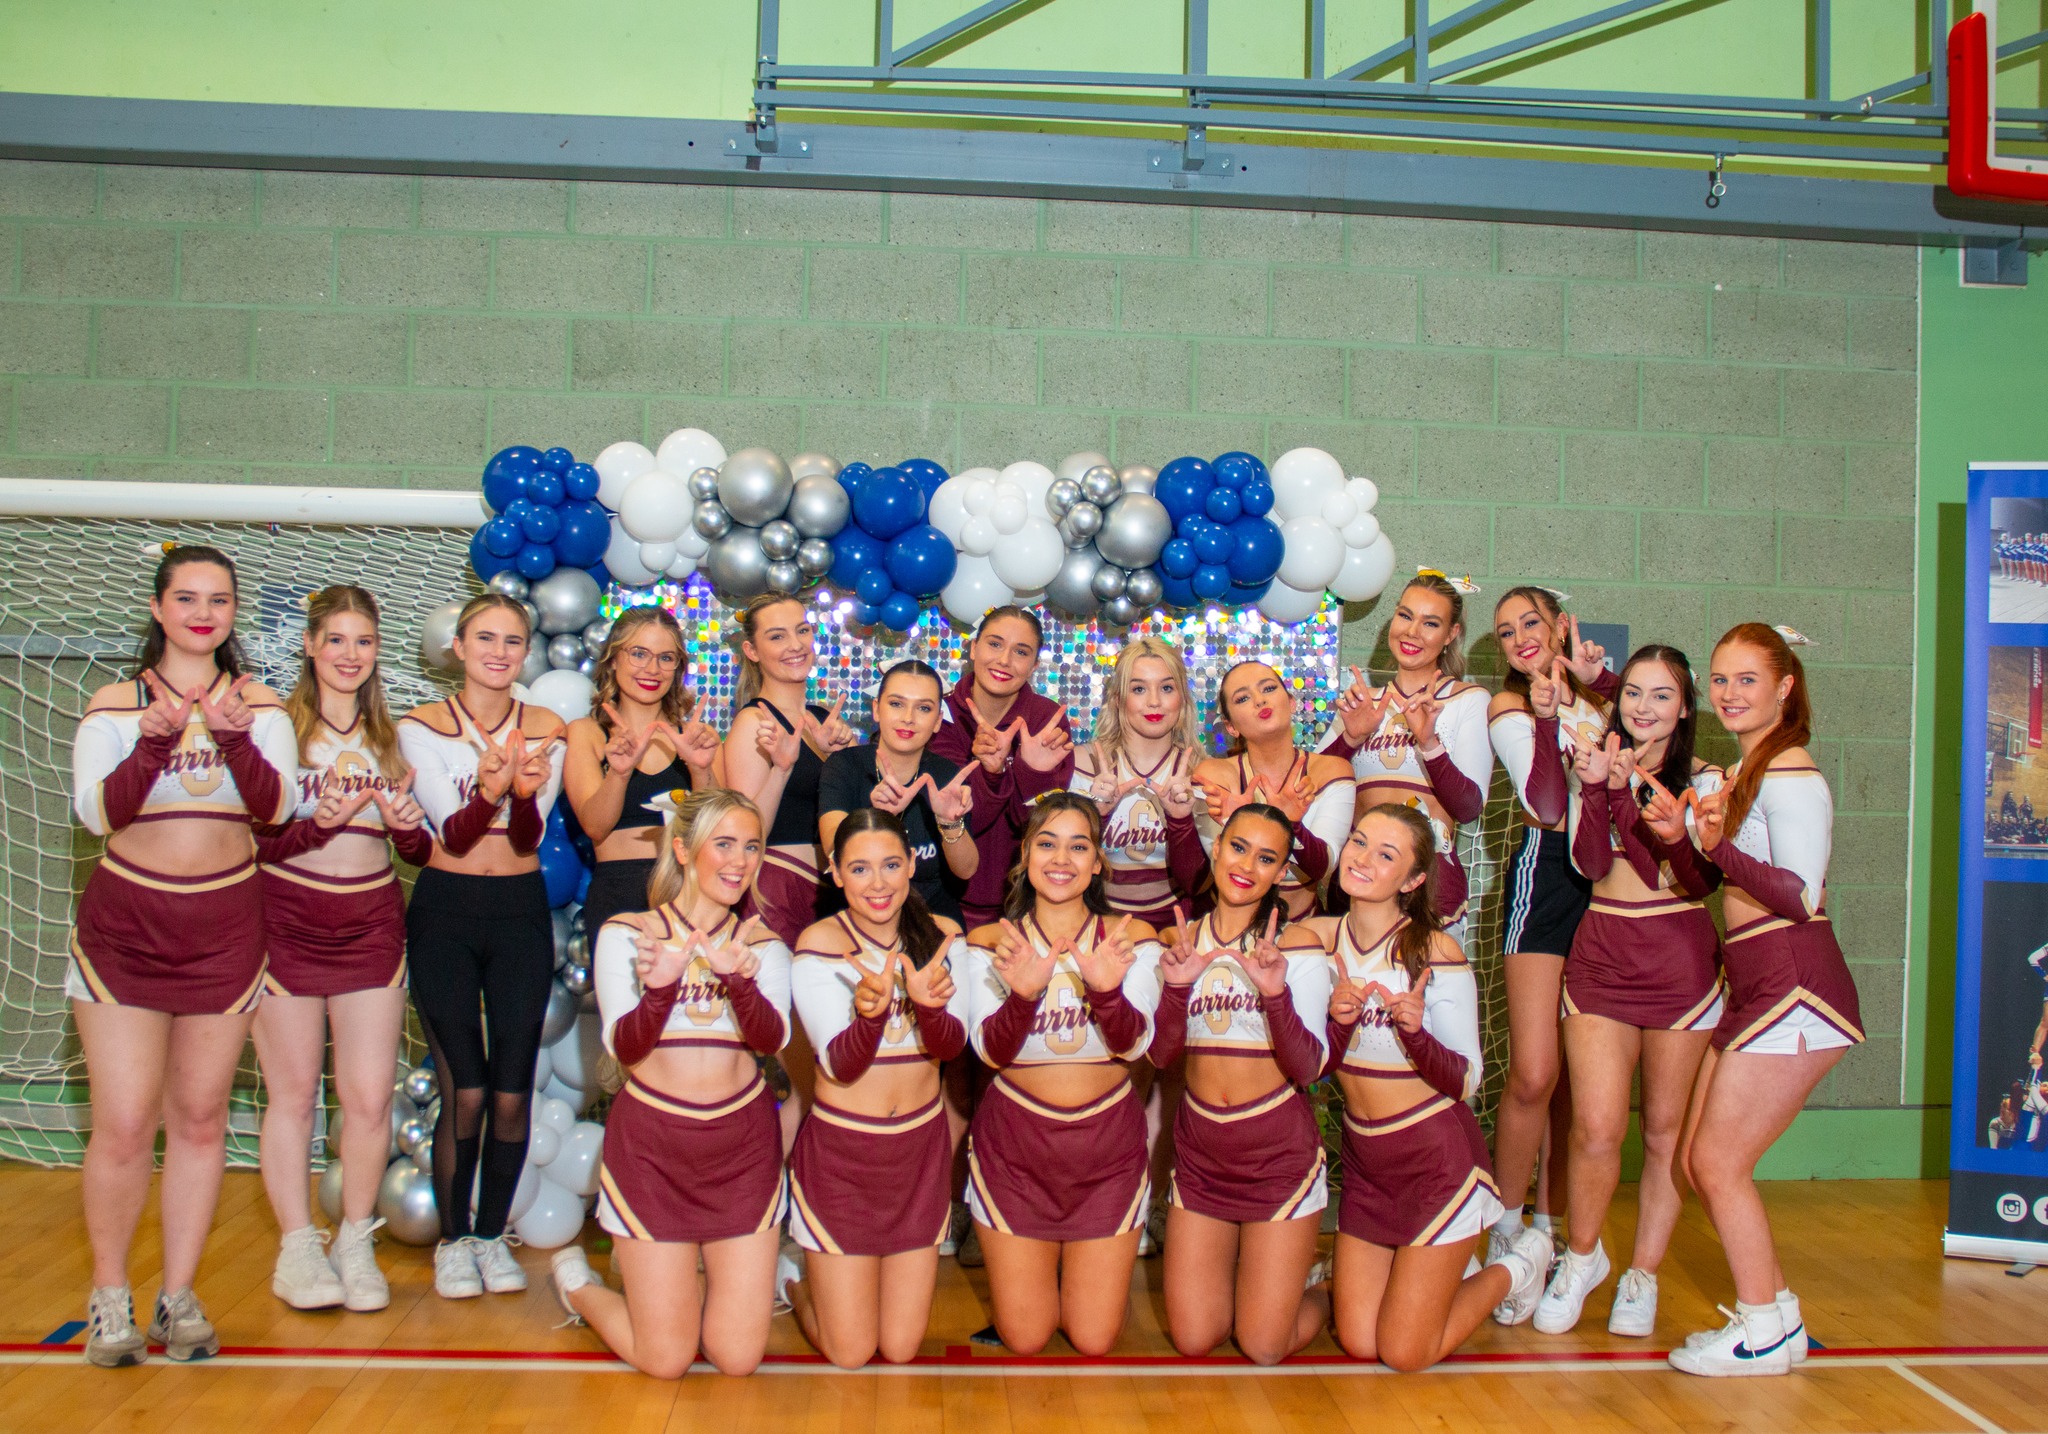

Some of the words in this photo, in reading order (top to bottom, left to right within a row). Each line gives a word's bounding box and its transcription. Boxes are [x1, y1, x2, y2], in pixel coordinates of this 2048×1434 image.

[1357, 728, 1418, 756] Warrio
[164, 748, 224, 776] arri
[298, 769, 400, 803] Wrriors
[1101, 819, 1168, 849] Warrio
[677, 982, 729, 1004] arri
[1189, 986, 1264, 1017] arriors
[1202, 966, 1233, 1035] S
[1028, 1005, 1090, 1035] arri
[1044, 971, 1087, 1055] S
